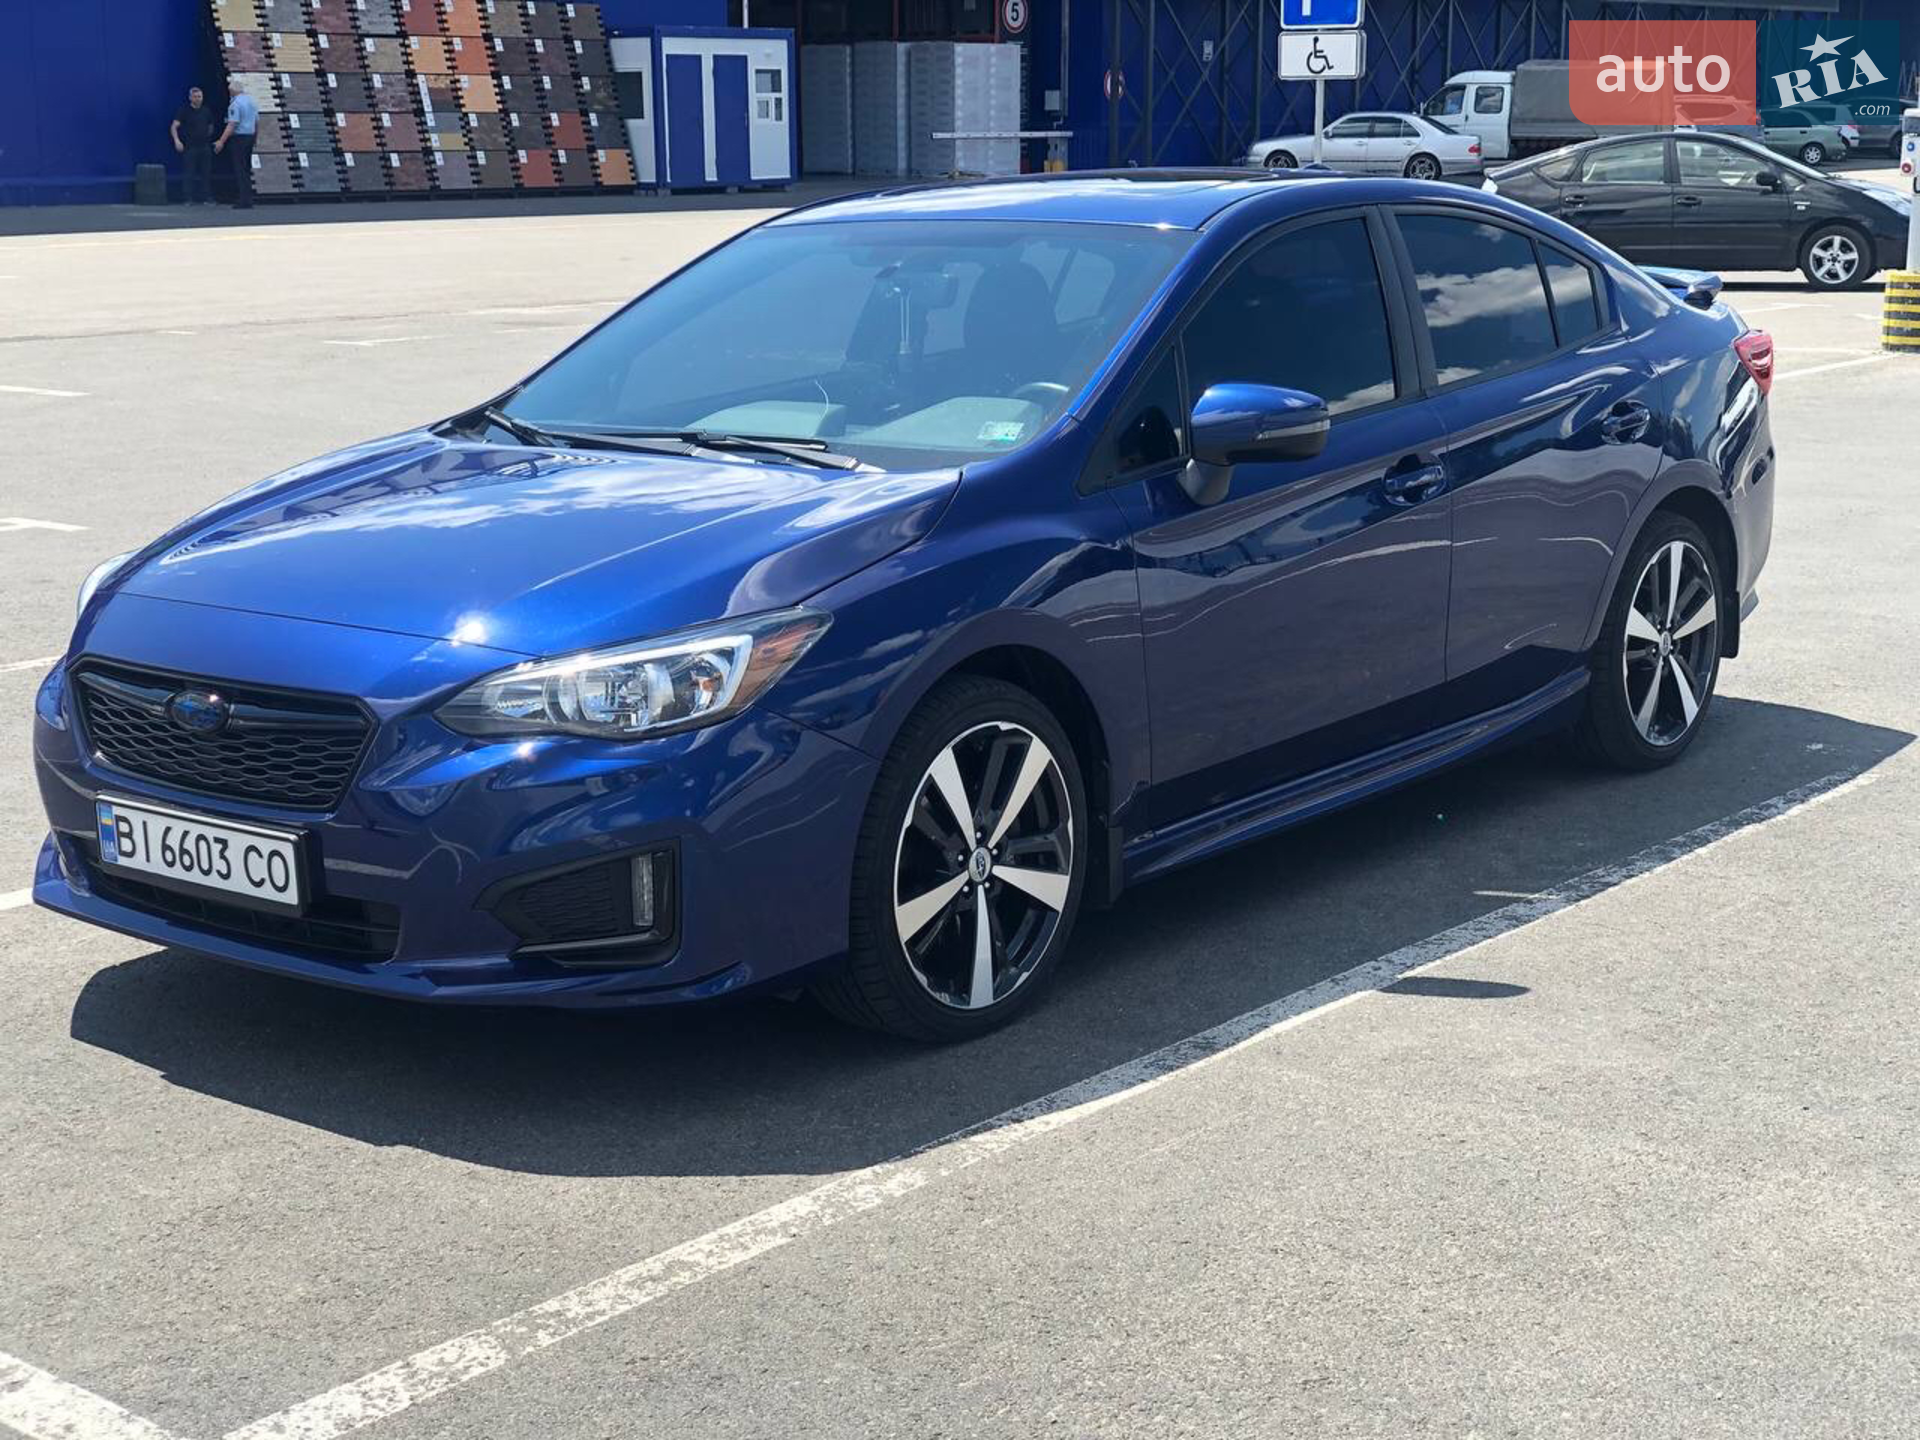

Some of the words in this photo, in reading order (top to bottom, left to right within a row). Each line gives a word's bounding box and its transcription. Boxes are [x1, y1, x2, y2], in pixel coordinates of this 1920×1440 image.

[1010, 2, 1020, 22] 5
[114, 814, 150, 863] BI
[161, 826, 232, 881] 6603
[243, 844, 290, 893] CO
